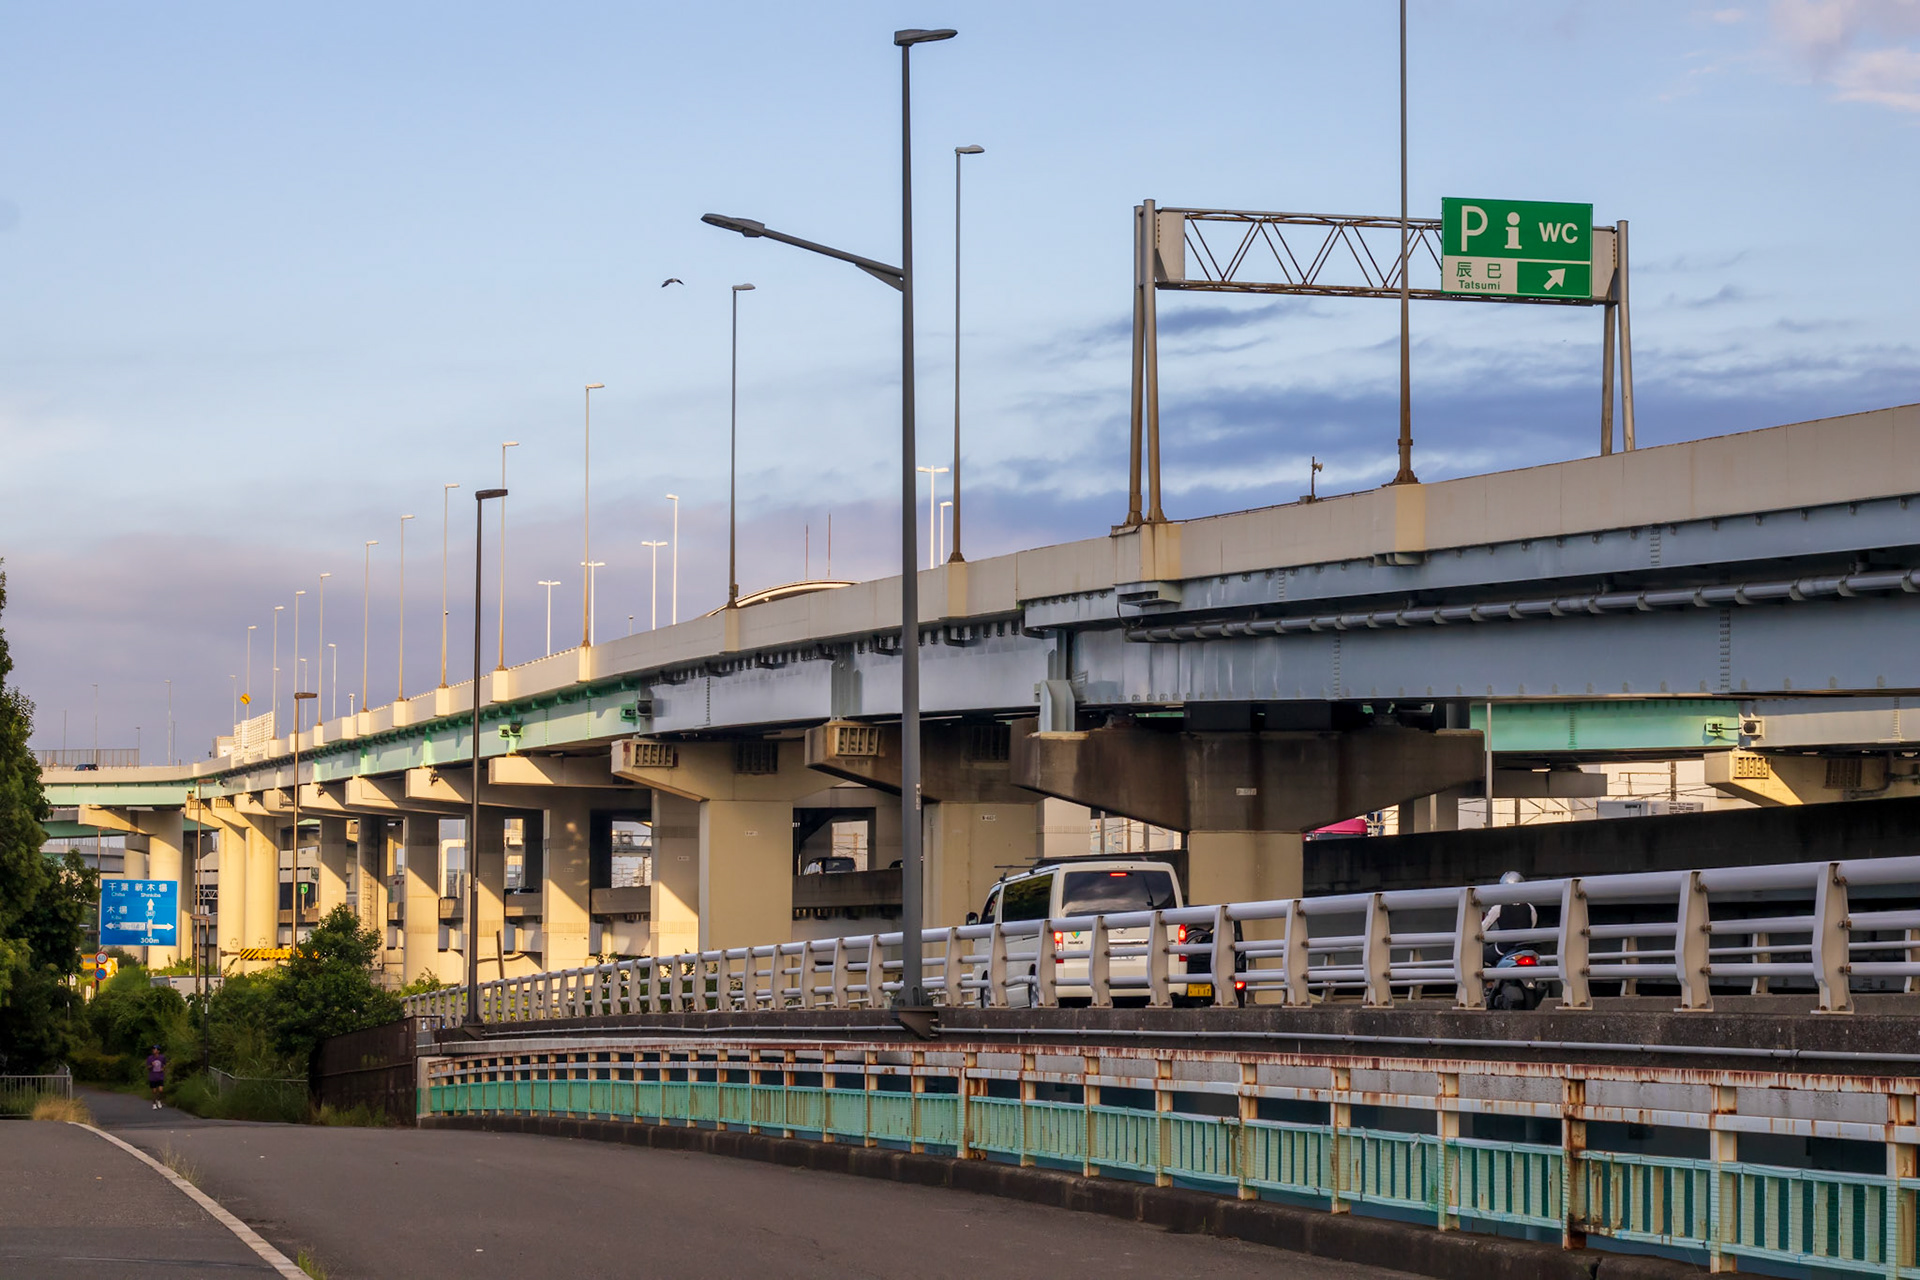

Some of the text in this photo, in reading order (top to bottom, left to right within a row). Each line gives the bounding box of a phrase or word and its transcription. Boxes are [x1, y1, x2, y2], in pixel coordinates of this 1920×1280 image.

[1461, 205, 1488, 252] P
[1538, 222, 1578, 244] WC
[1456, 261, 1502, 279] 辰巳
[1458, 280, 1501, 290] Tatsumi
[108, 882, 168, 893] 千葉 新木場
[106, 905, 128, 914] 木場
